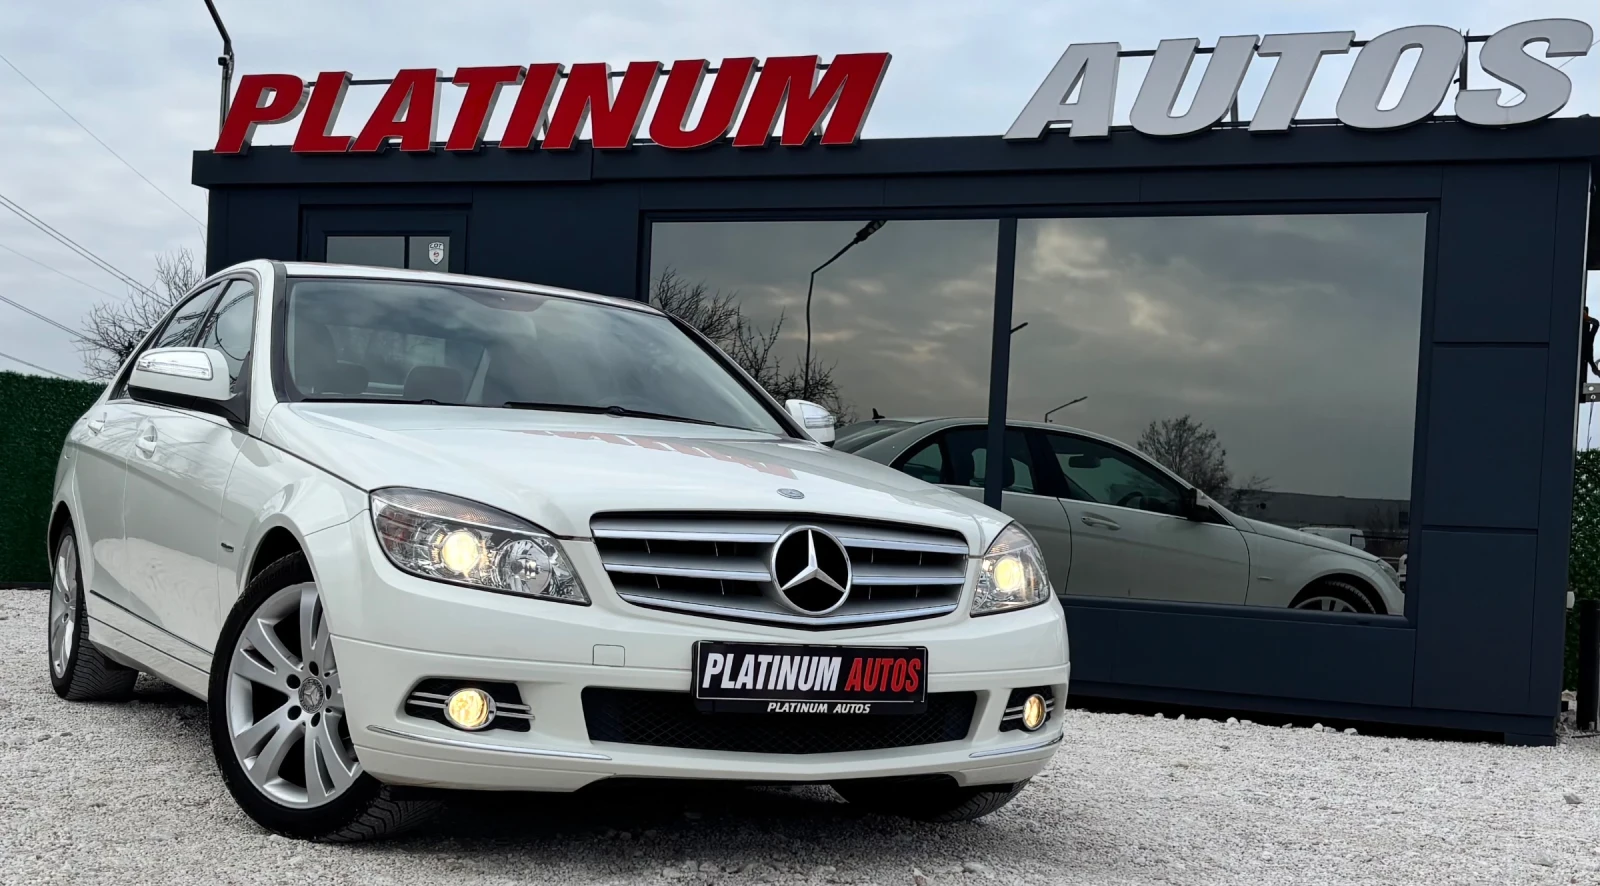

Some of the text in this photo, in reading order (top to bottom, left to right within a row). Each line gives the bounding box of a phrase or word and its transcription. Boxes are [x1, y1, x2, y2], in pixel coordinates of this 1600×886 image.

[213, 18, 1594, 154] PLATINUM AUTOS
[702, 652, 921, 693] PLATINUM AUTOS
[767, 702, 871, 714] PLATINUM AUTOS
